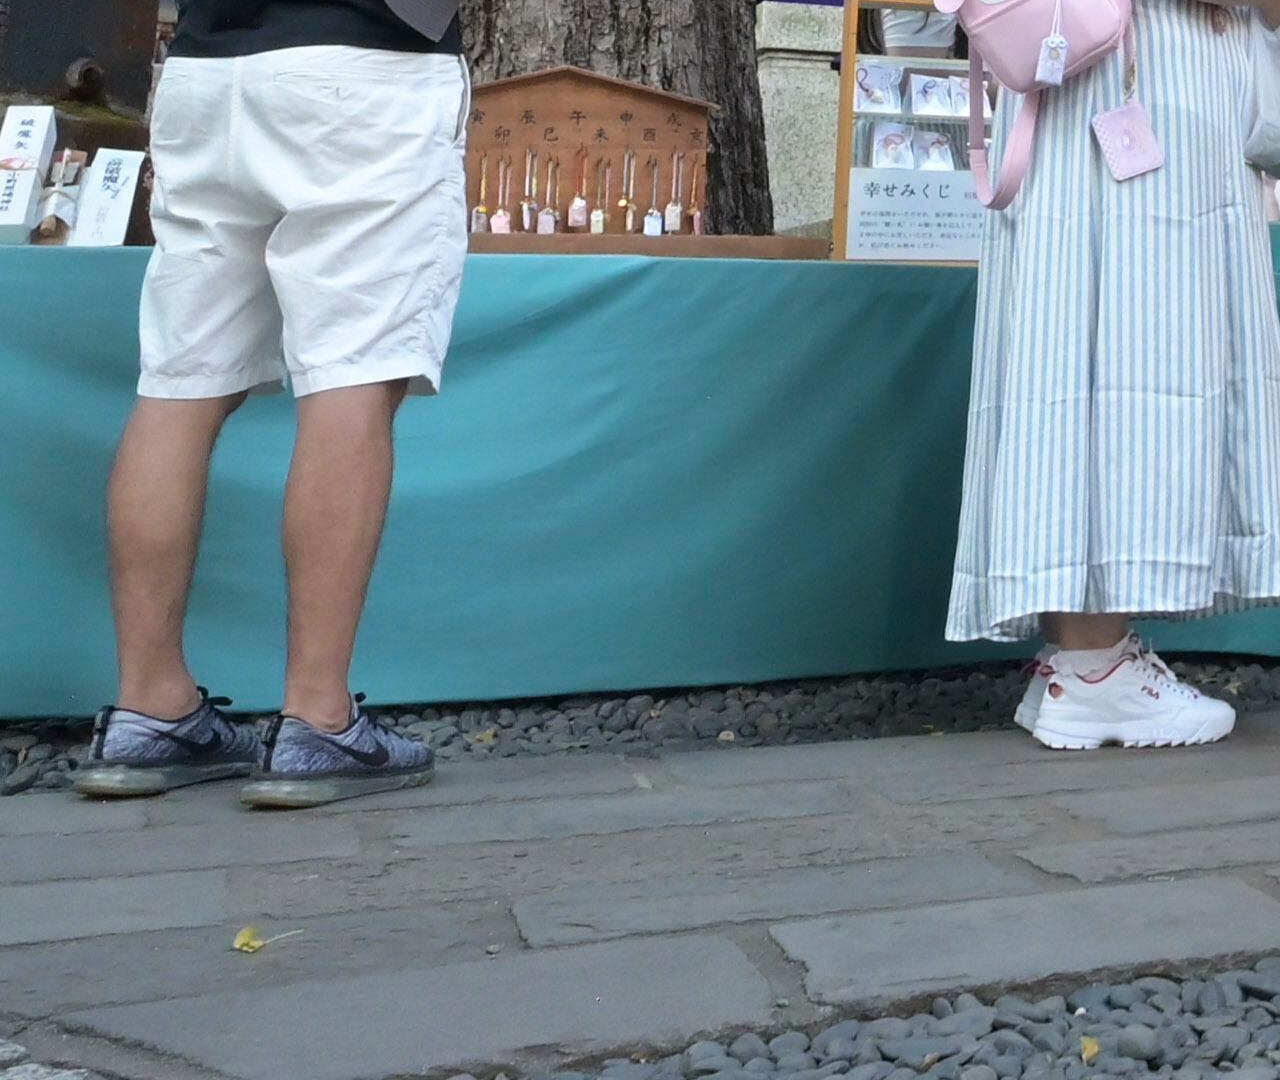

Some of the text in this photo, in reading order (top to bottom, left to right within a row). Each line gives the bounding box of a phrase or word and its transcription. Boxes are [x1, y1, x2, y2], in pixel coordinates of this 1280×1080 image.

[520, 110, 537, 125] 辰
[570, 111, 587, 126] 午
[620, 111, 634, 126] 申
[495, 126, 510, 145] 卯
[642, 128, 657, 142] 酉
[863, 181, 951, 199] 幸せみくじ
